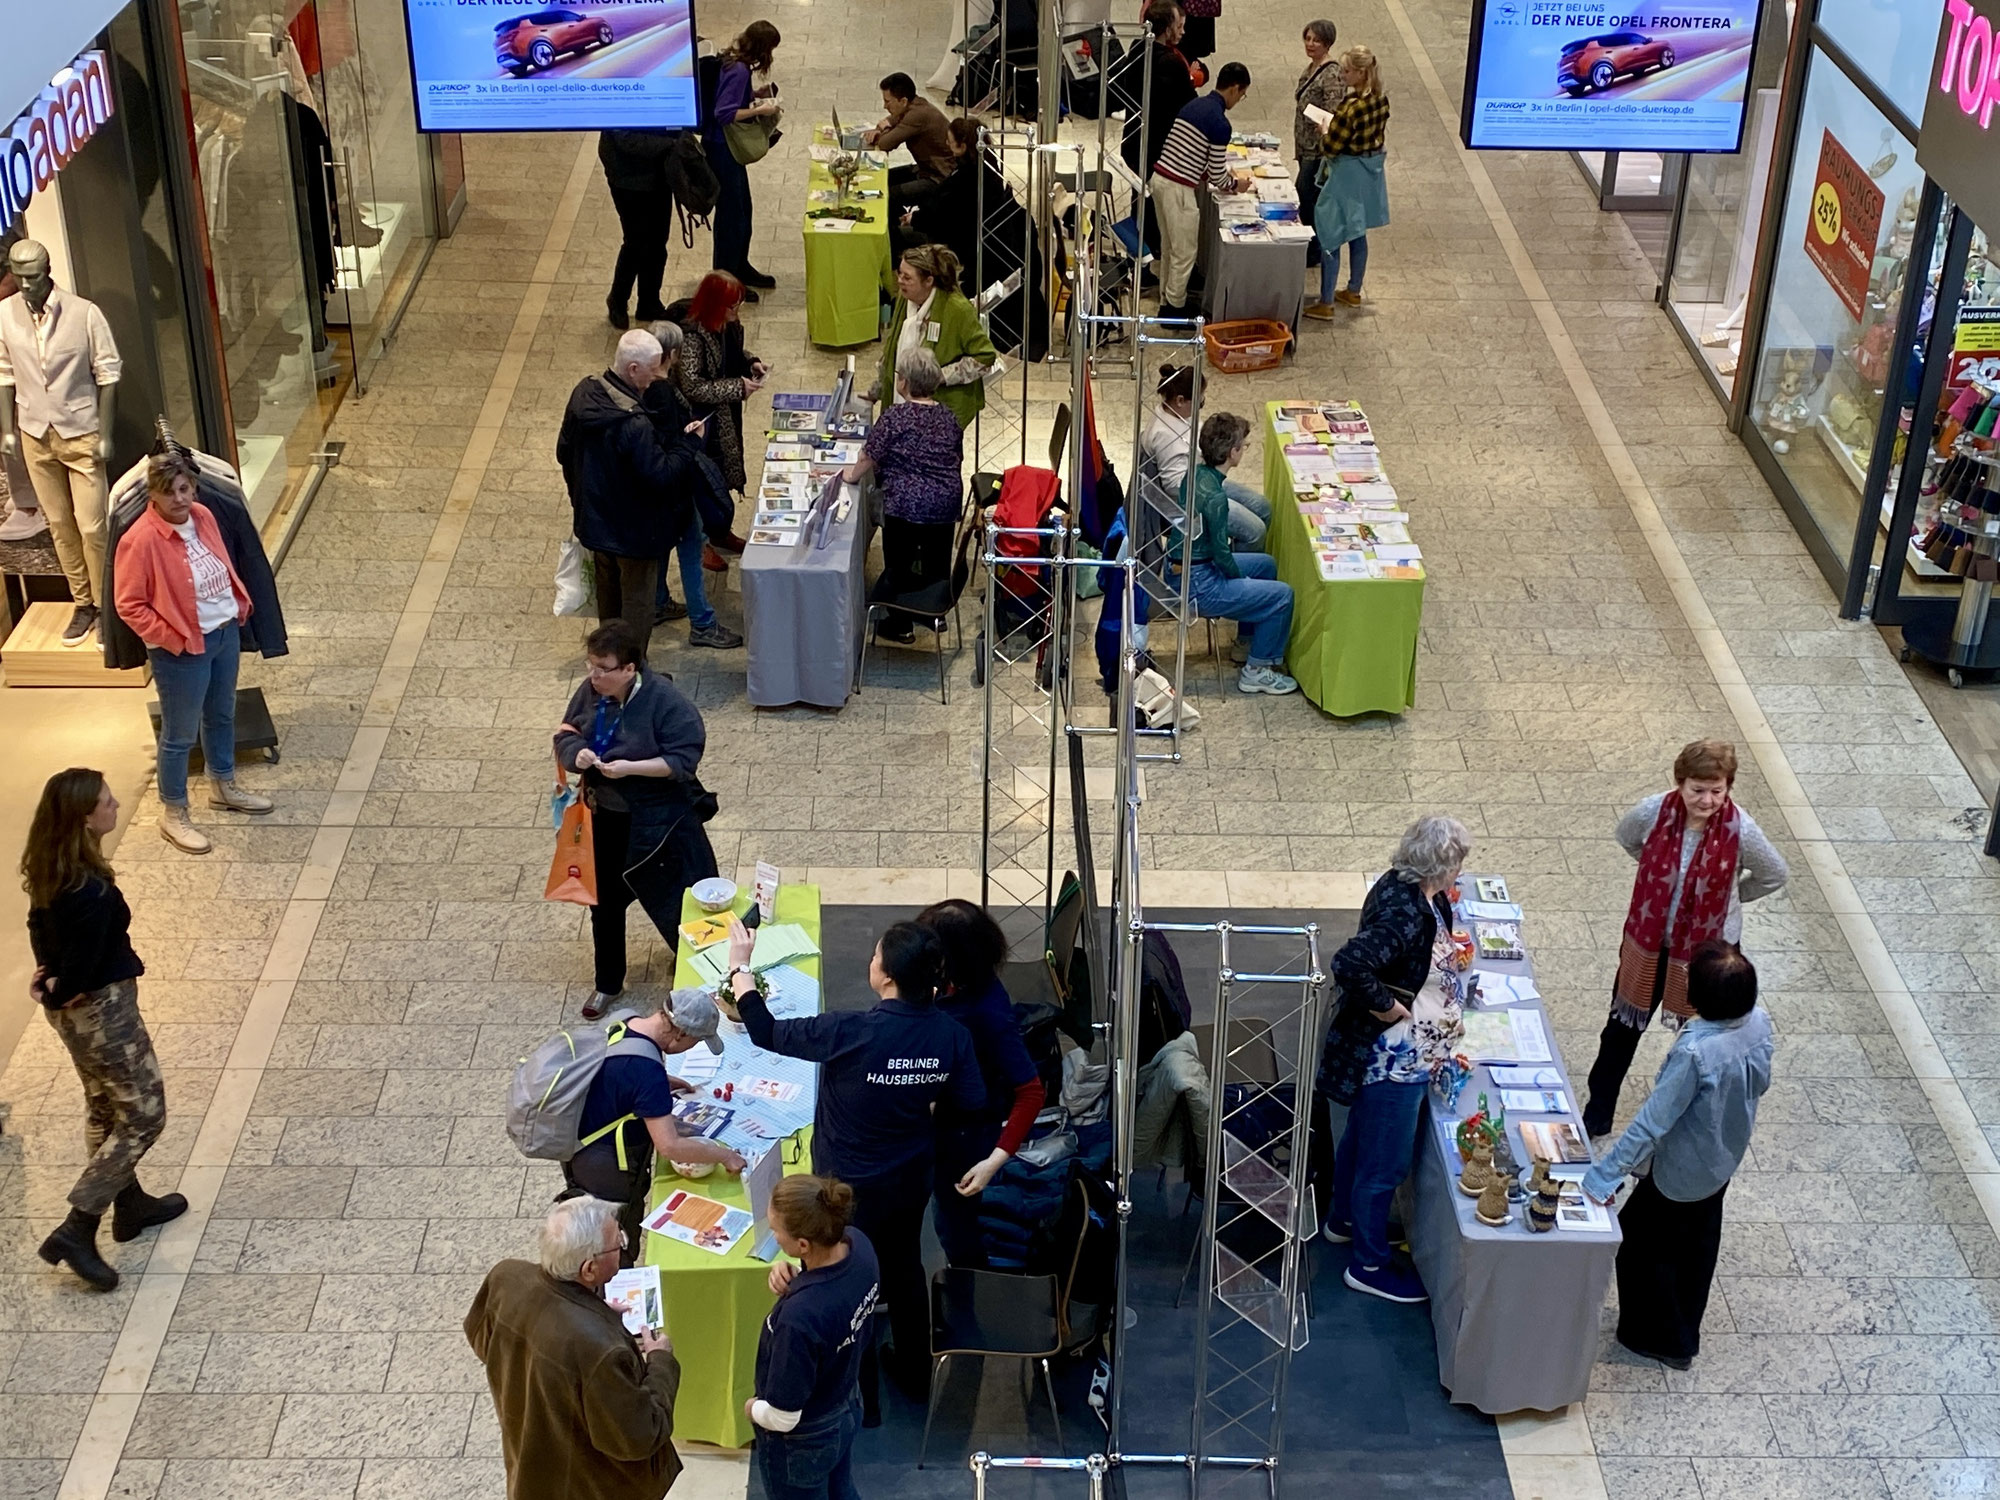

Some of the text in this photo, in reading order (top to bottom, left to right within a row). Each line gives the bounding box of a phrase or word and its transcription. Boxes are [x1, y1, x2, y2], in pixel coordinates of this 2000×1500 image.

[1532, 2, 1605, 12] JETZT BEI UNS
[1532, 14, 1731, 29] DER NEUE OPEL FRONTERA
[475, 84, 487, 93] 3x
[490, 84, 499, 93] in
[501, 83, 529, 93] Berlin
[536, 82, 646, 93] opel-dello-duerkop.de
[1530, 103, 1542, 112] 3x
[1544, 103, 1553, 112] in
[1555, 103, 1582, 113] Berlin
[1589, 104, 1694, 115] opel-dello-duerkop.de
[1817, 194, 1837, 233] 25%
[887, 1058, 940, 1070] BERLINER
[866, 1073, 949, 1085] HAUSBESUCHE
